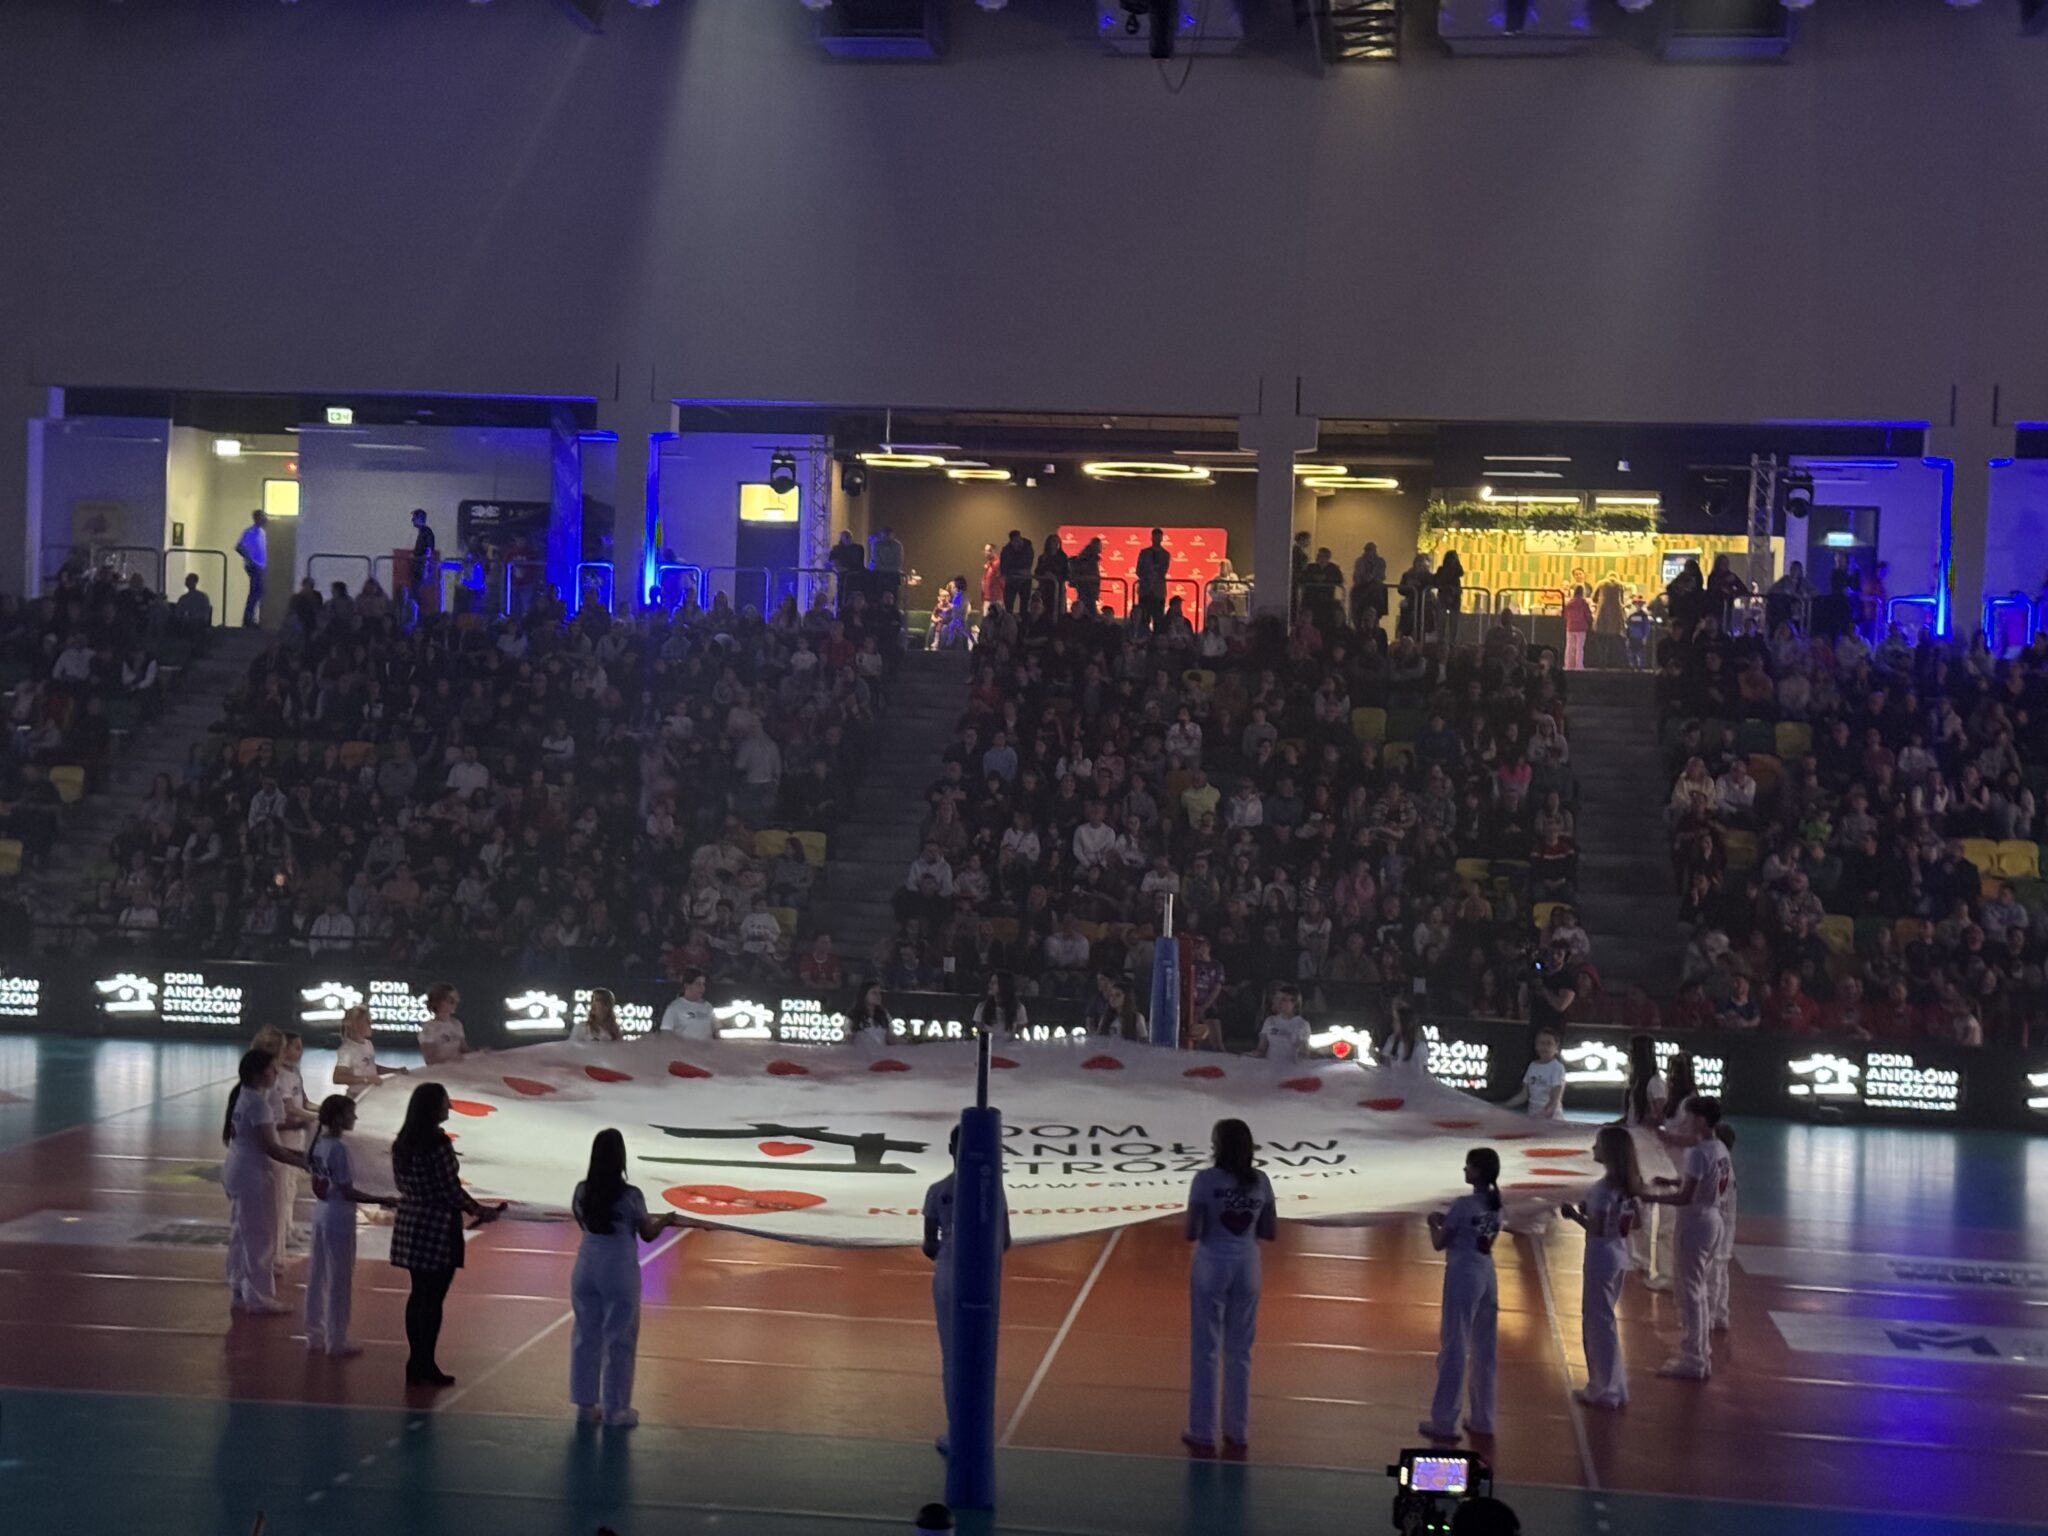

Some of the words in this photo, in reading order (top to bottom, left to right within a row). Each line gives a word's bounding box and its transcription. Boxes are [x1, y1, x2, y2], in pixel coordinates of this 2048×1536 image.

[164, 972, 204, 986] DOM
[370, 981, 409, 995] DOM
[781, 999, 821, 1013] DOM
[780, 1012, 847, 1028] ANIOŁÓ
[891, 1018, 963, 1038] STAR
[1867, 1052, 1913, 1068] DOM
